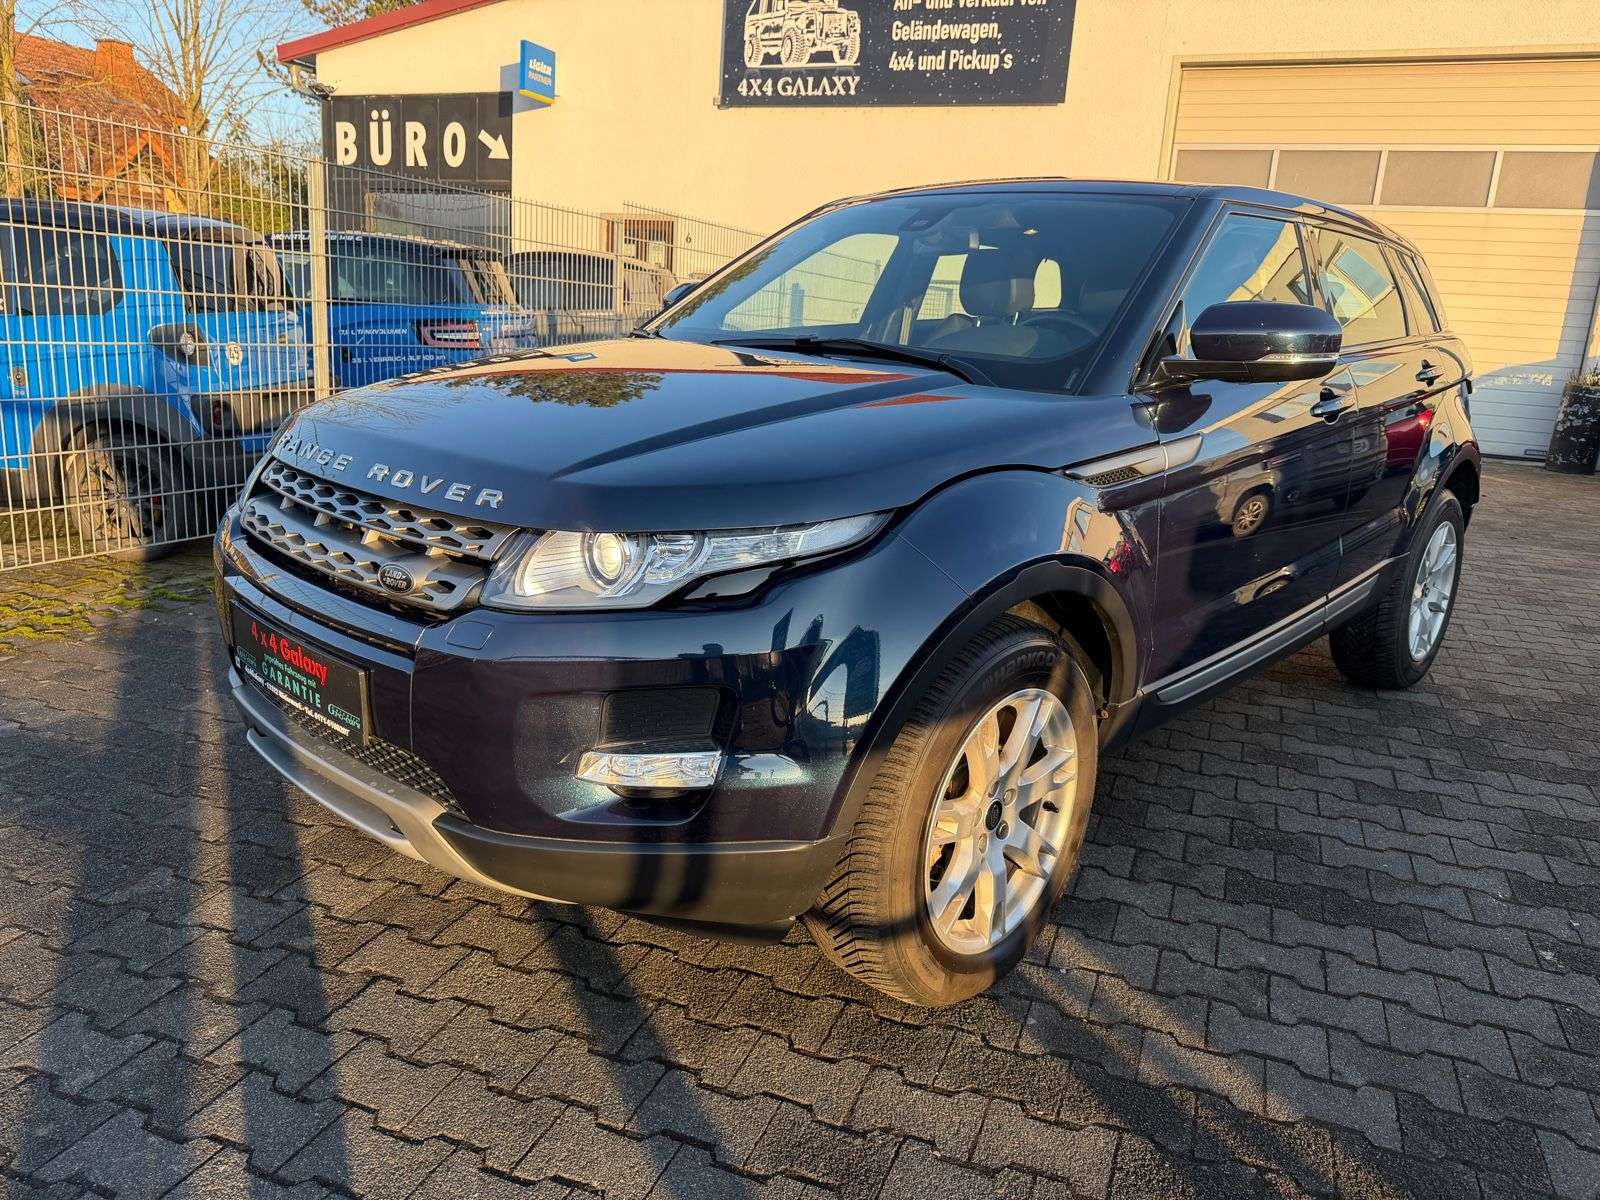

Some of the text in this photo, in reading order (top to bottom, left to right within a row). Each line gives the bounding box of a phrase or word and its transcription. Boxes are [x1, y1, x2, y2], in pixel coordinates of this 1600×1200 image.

[891, 19, 1002, 44] Geländewagen,
[888, 51, 915, 71] 4x4
[918, 50, 946, 70] und
[737, 75, 861, 97] 4X4 GALAXY
[335, 109, 467, 168] BÜRO
[685, 232, 692, 244] 6
[277, 432, 504, 509] RANGE ROVER
[384, 568, 402, 580] LAND
[385, 577, 407, 590] ROVER
[251, 621, 259, 642] 4
[269, 632, 278, 655] 4
[279, 638, 329, 687] Galaxy
[261, 662, 321, 708] GARANTIE
